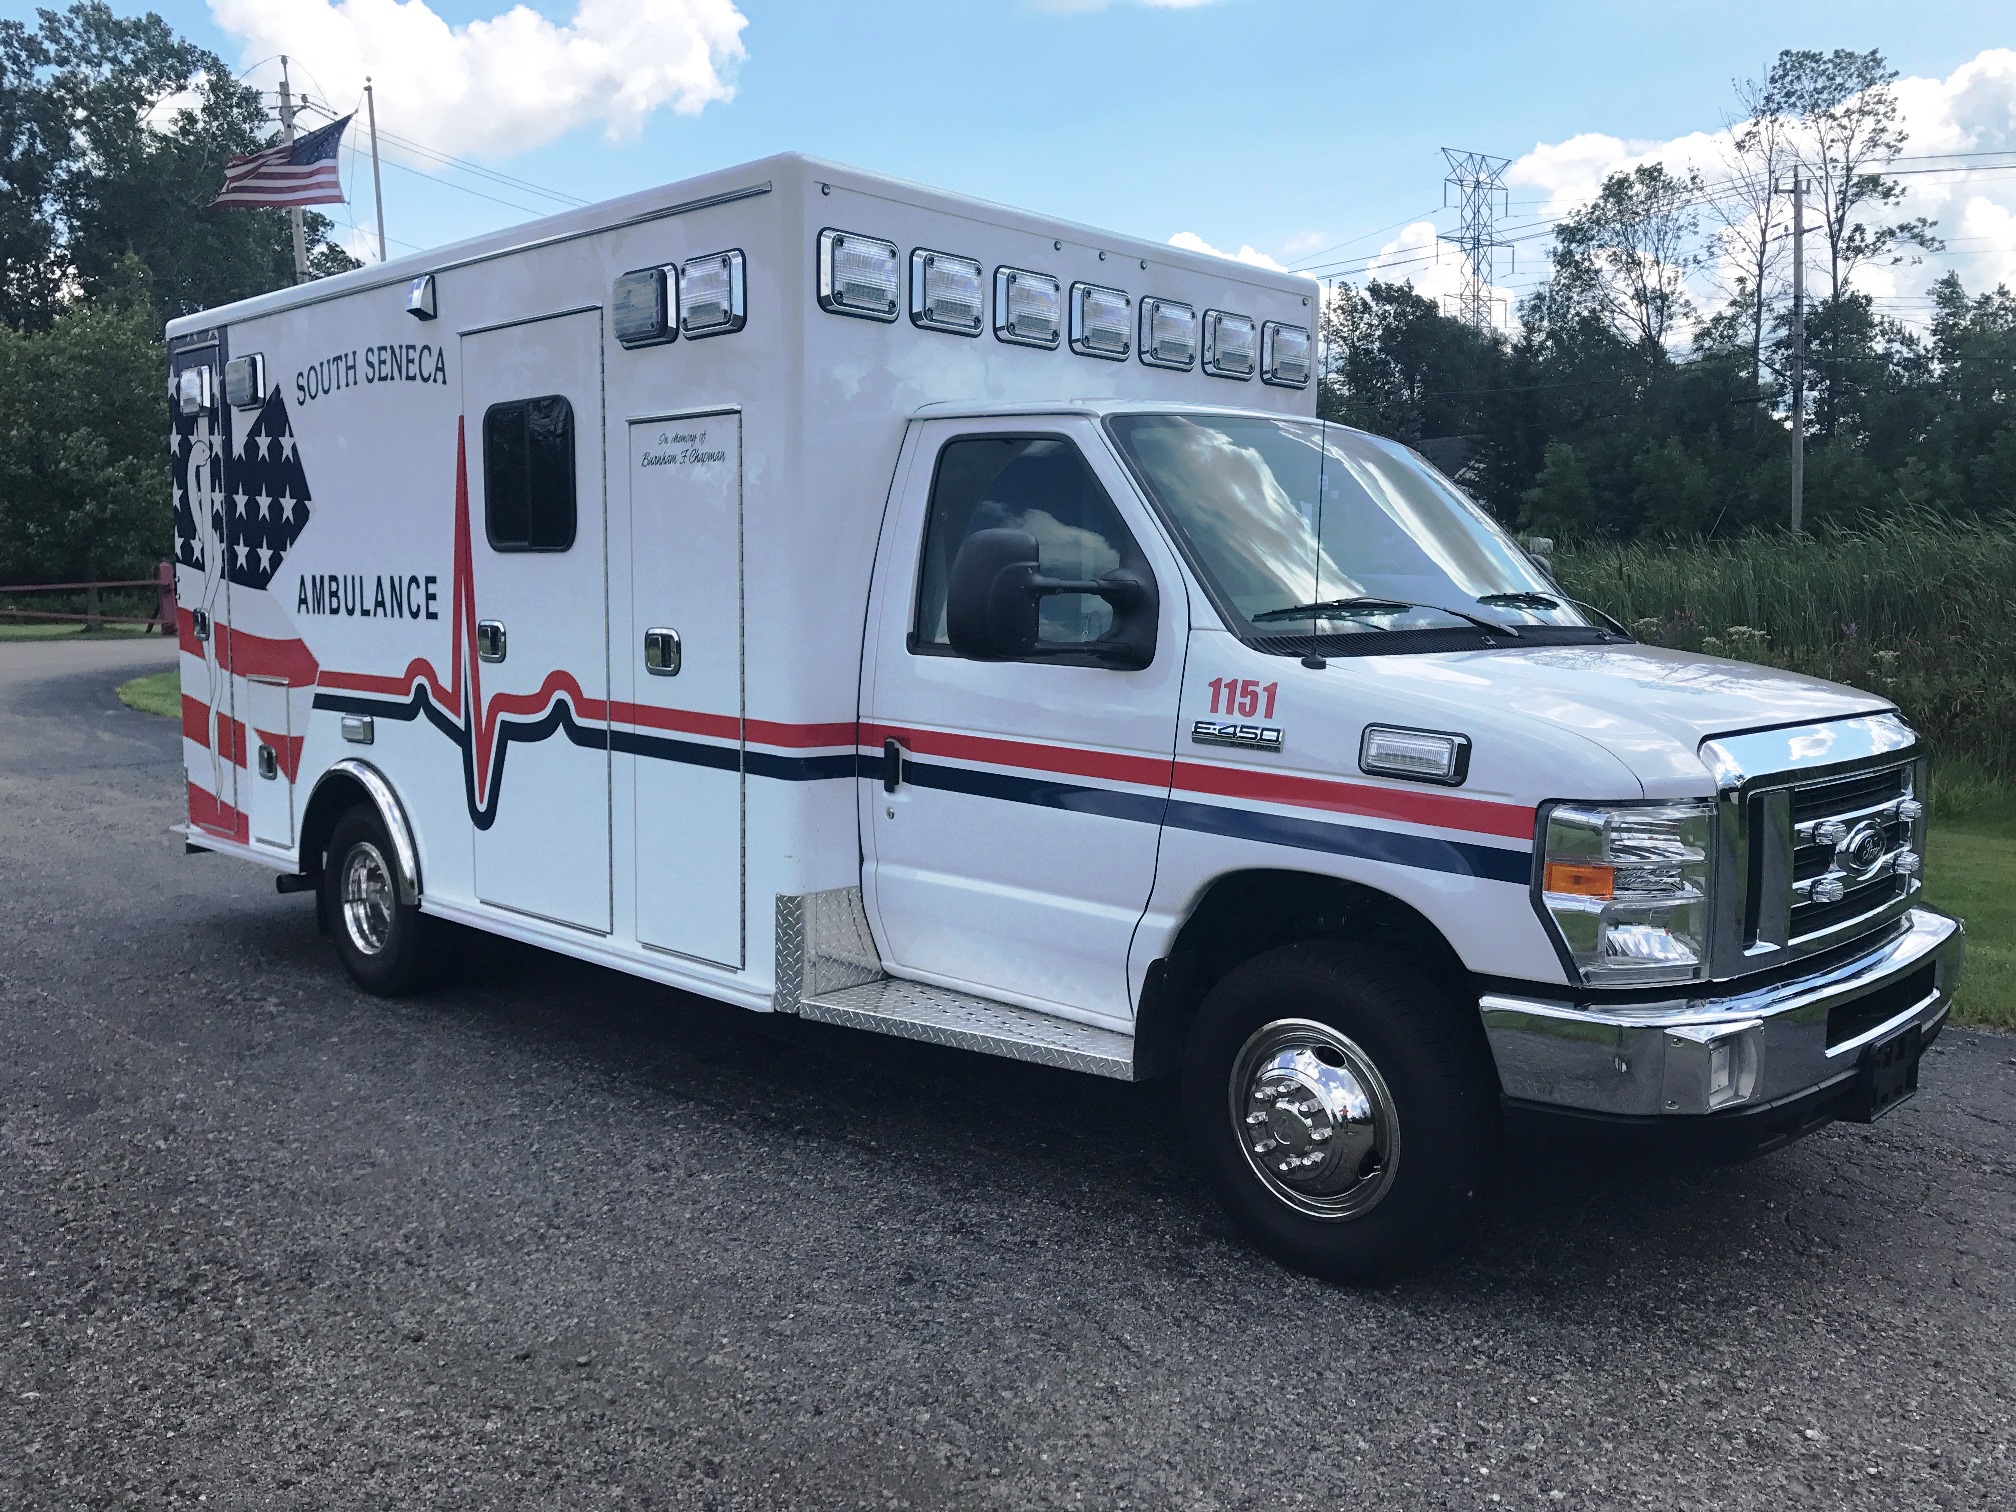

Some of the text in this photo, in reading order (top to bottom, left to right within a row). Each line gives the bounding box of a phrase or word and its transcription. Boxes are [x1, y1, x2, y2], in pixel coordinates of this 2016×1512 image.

[296, 344, 447, 406] SOUTH SENECA
[699, 430, 707, 446] of
[641, 451, 678, 467] Burnham
[688, 448, 726, 466] Chapman
[297, 574, 439, 620] AMBULANCE
[1208, 677, 1278, 719] 1151
[1862, 837, 1883, 861] Ford
